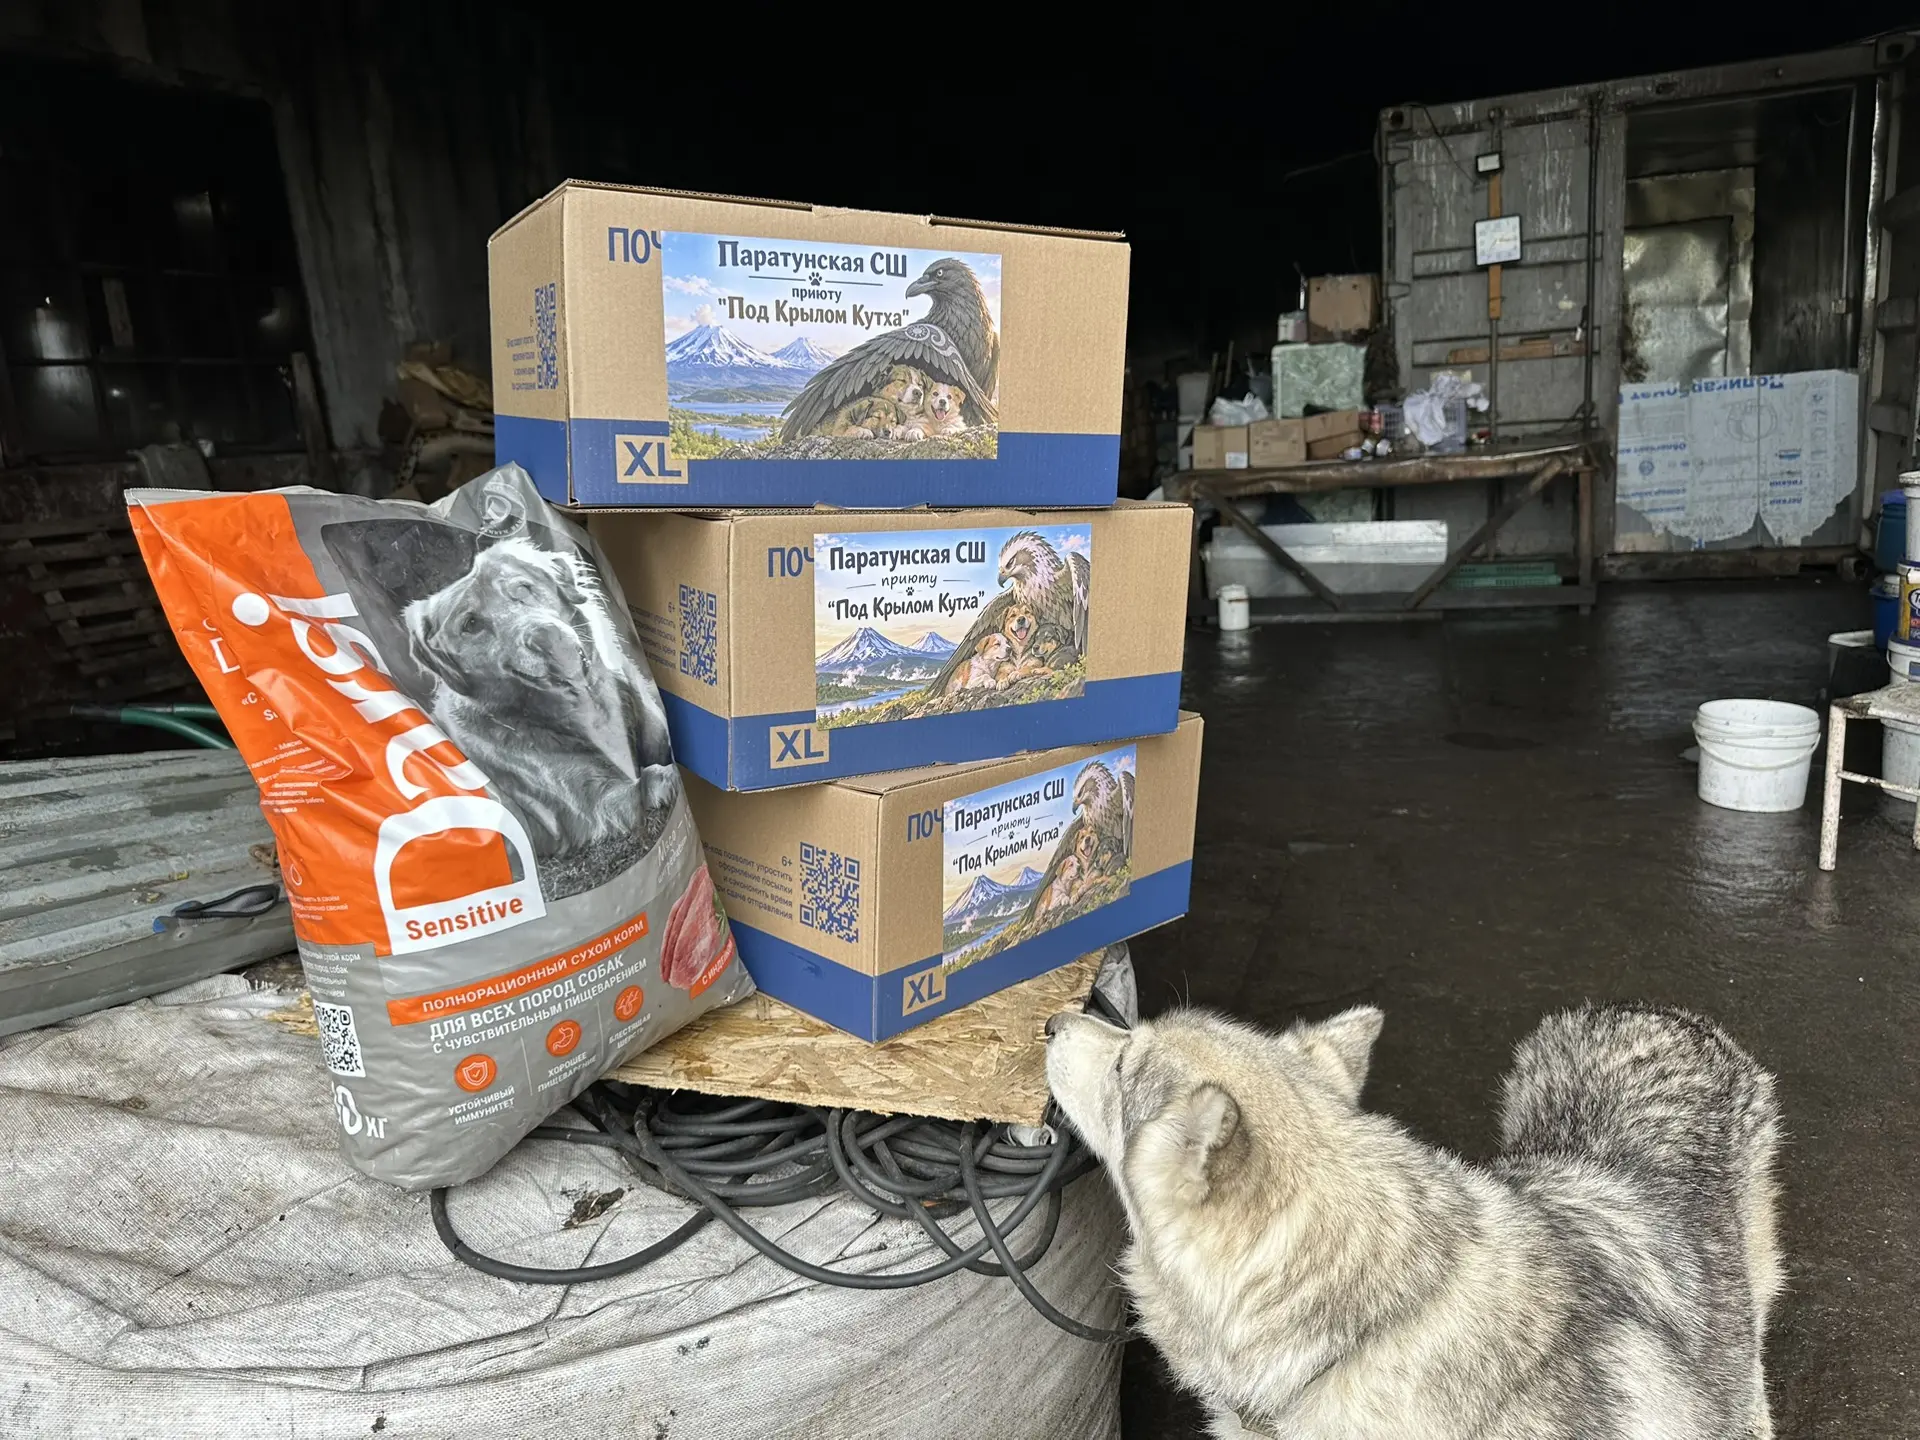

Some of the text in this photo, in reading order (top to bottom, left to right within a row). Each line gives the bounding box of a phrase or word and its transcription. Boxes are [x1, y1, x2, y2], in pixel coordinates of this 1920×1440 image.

[717, 240, 907, 278] Паратунская СШ
[792, 287, 842, 303] приюту
[718, 296, 910, 330] "Под Крылом Кутха"
[623, 441, 682, 476] XL
[830, 541, 986, 575] Паратунская СШ
[881, 574, 938, 590] приюту
[828, 591, 985, 622] “Под Крылом Кутха”
[776, 728, 825, 762] XL
[955, 778, 1065, 832] Паратунская СШ
[991, 816, 1031, 838] приюту
[781, 855, 793, 866] 6+
[952, 821, 1064, 875] “Под Крылом Кутха”
[723, 850, 755, 868] позволит
[756, 863, 793, 882] упростить
[728, 877, 769, 899] сэкономить
[770, 893, 793, 907] время
[762, 877, 793, 895] посылки
[405, 897, 524, 941] Sensitive
[747, 897, 793, 920] отправления
[422, 919, 645, 1013] ПОЛНОРАЦИОННЫЙ СУХОЙ КОРМ
[430, 954, 625, 1042] ДЛЯ ВСЕХ ПОРОД СОБАК
[433, 958, 648, 1054] С ЧУВСТВИТЕЛЬНЫМ ПИЩЕВАРЕНИЕМ
[907, 972, 942, 1009] XL
[609, 1013, 652, 1044] БЛЕСТЯЩАЯ
[548, 1052, 588, 1077] ХОРОШЕЕ
[448, 1085, 515, 1116] УСТОЙЧИВЫЙ
[454, 1098, 515, 1126] ИММУНИТЕТ
